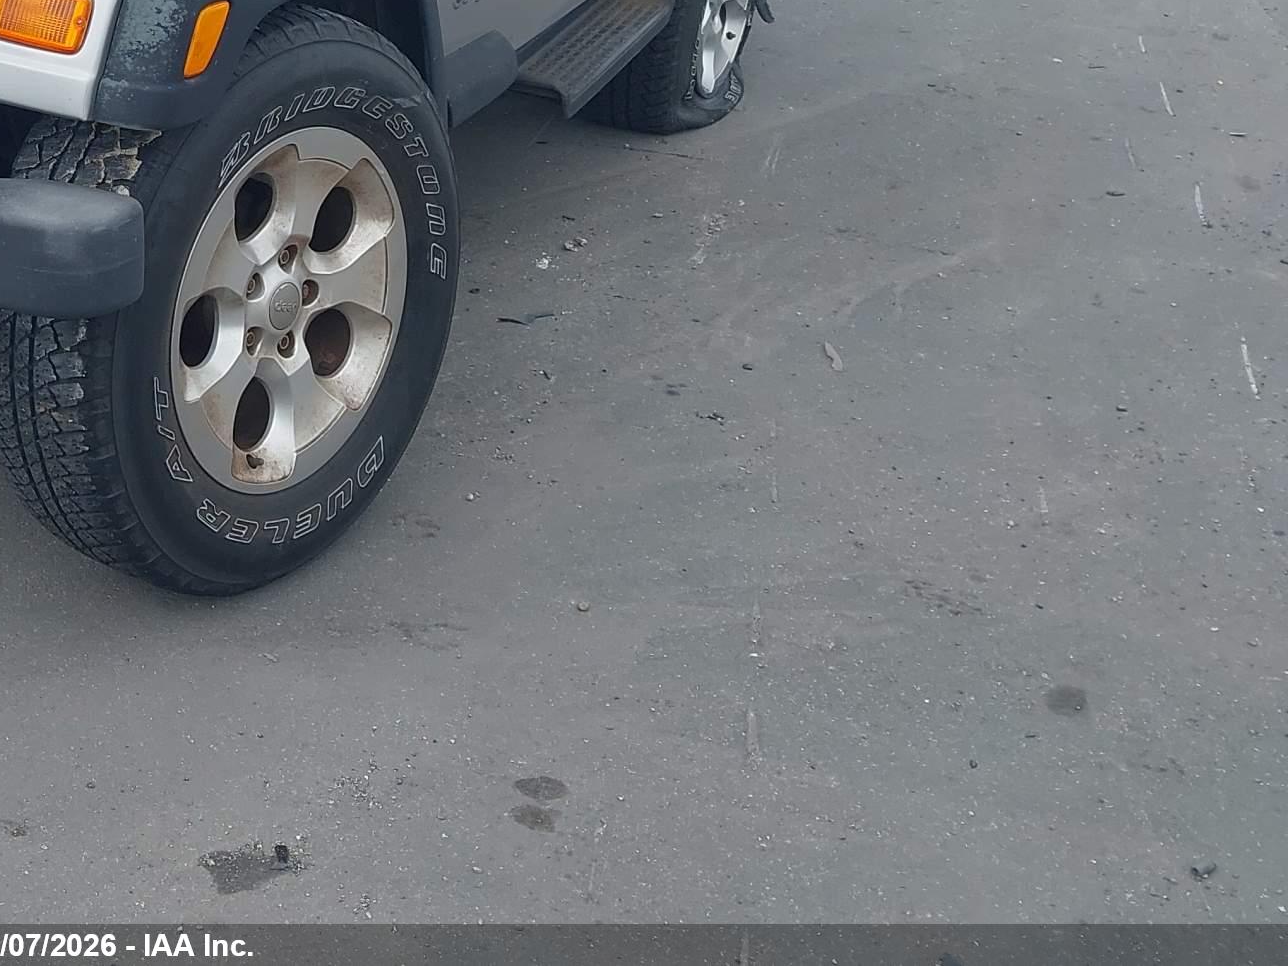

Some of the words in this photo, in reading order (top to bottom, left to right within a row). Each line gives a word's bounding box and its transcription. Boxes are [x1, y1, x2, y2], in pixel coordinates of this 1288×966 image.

[218, 86, 447, 280] BRIDGESTONE
[153, 376, 193, 482] A/T
[196, 434, 385, 544] DUELER
